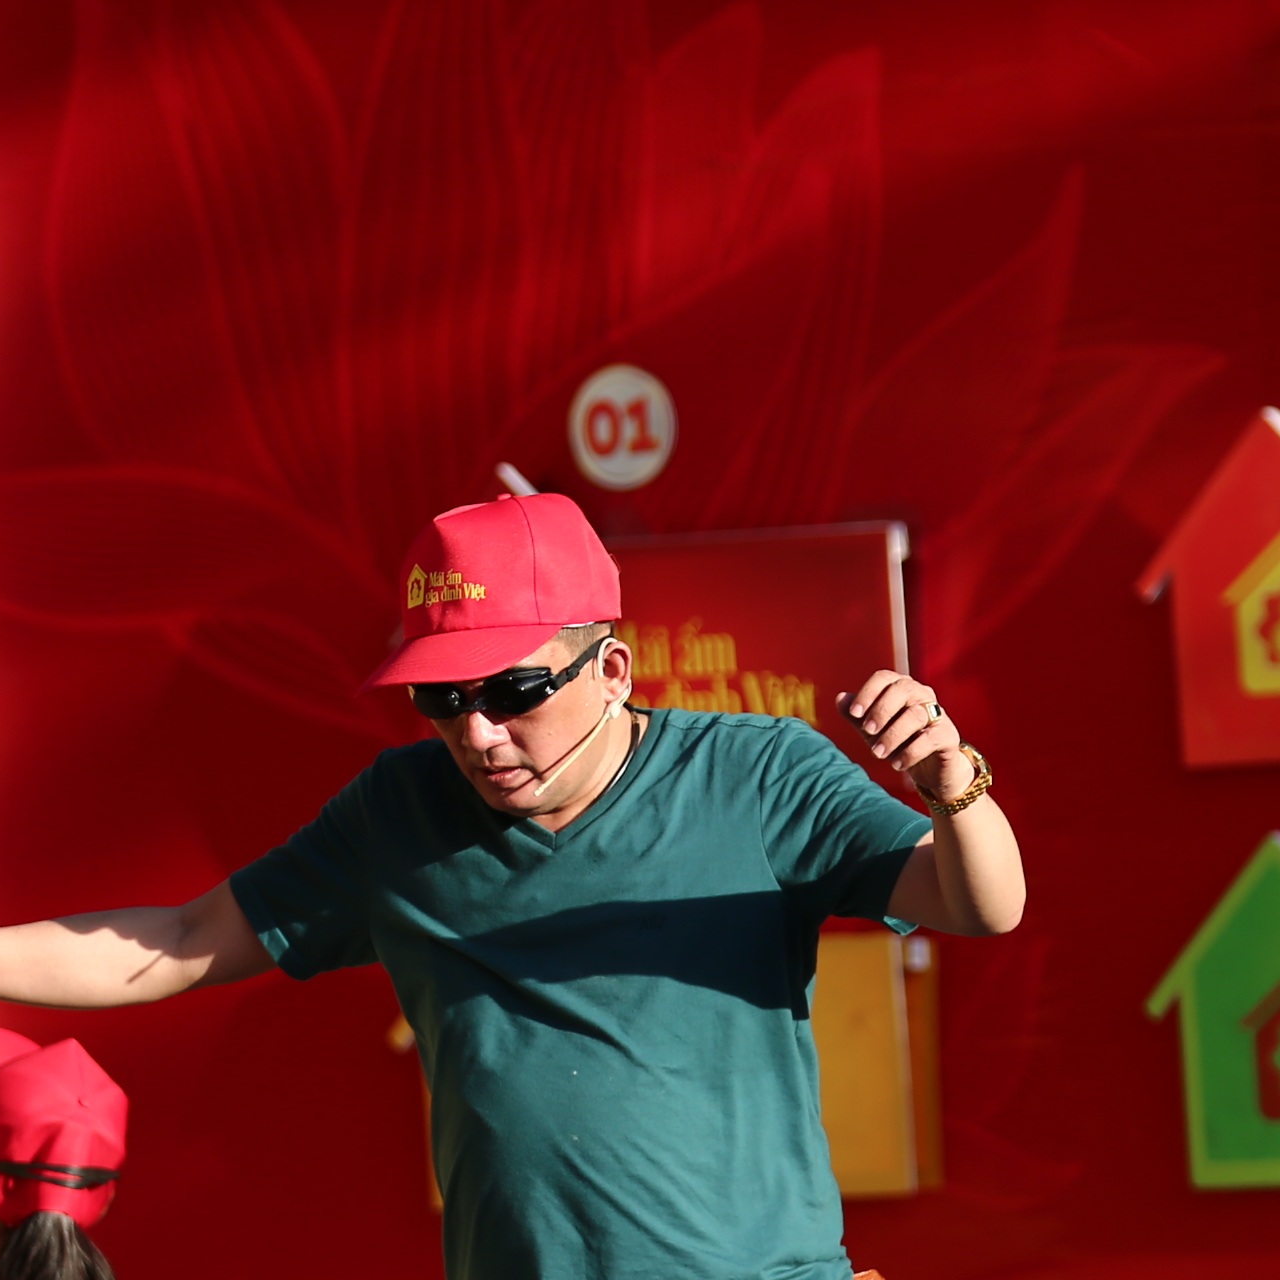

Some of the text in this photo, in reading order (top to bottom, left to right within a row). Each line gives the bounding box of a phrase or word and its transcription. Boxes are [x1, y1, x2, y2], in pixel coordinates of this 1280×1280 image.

[584, 397, 661, 457] 01
[429, 568, 462, 587] Mái ấm
[425, 582, 486, 608] gia đình Việt
